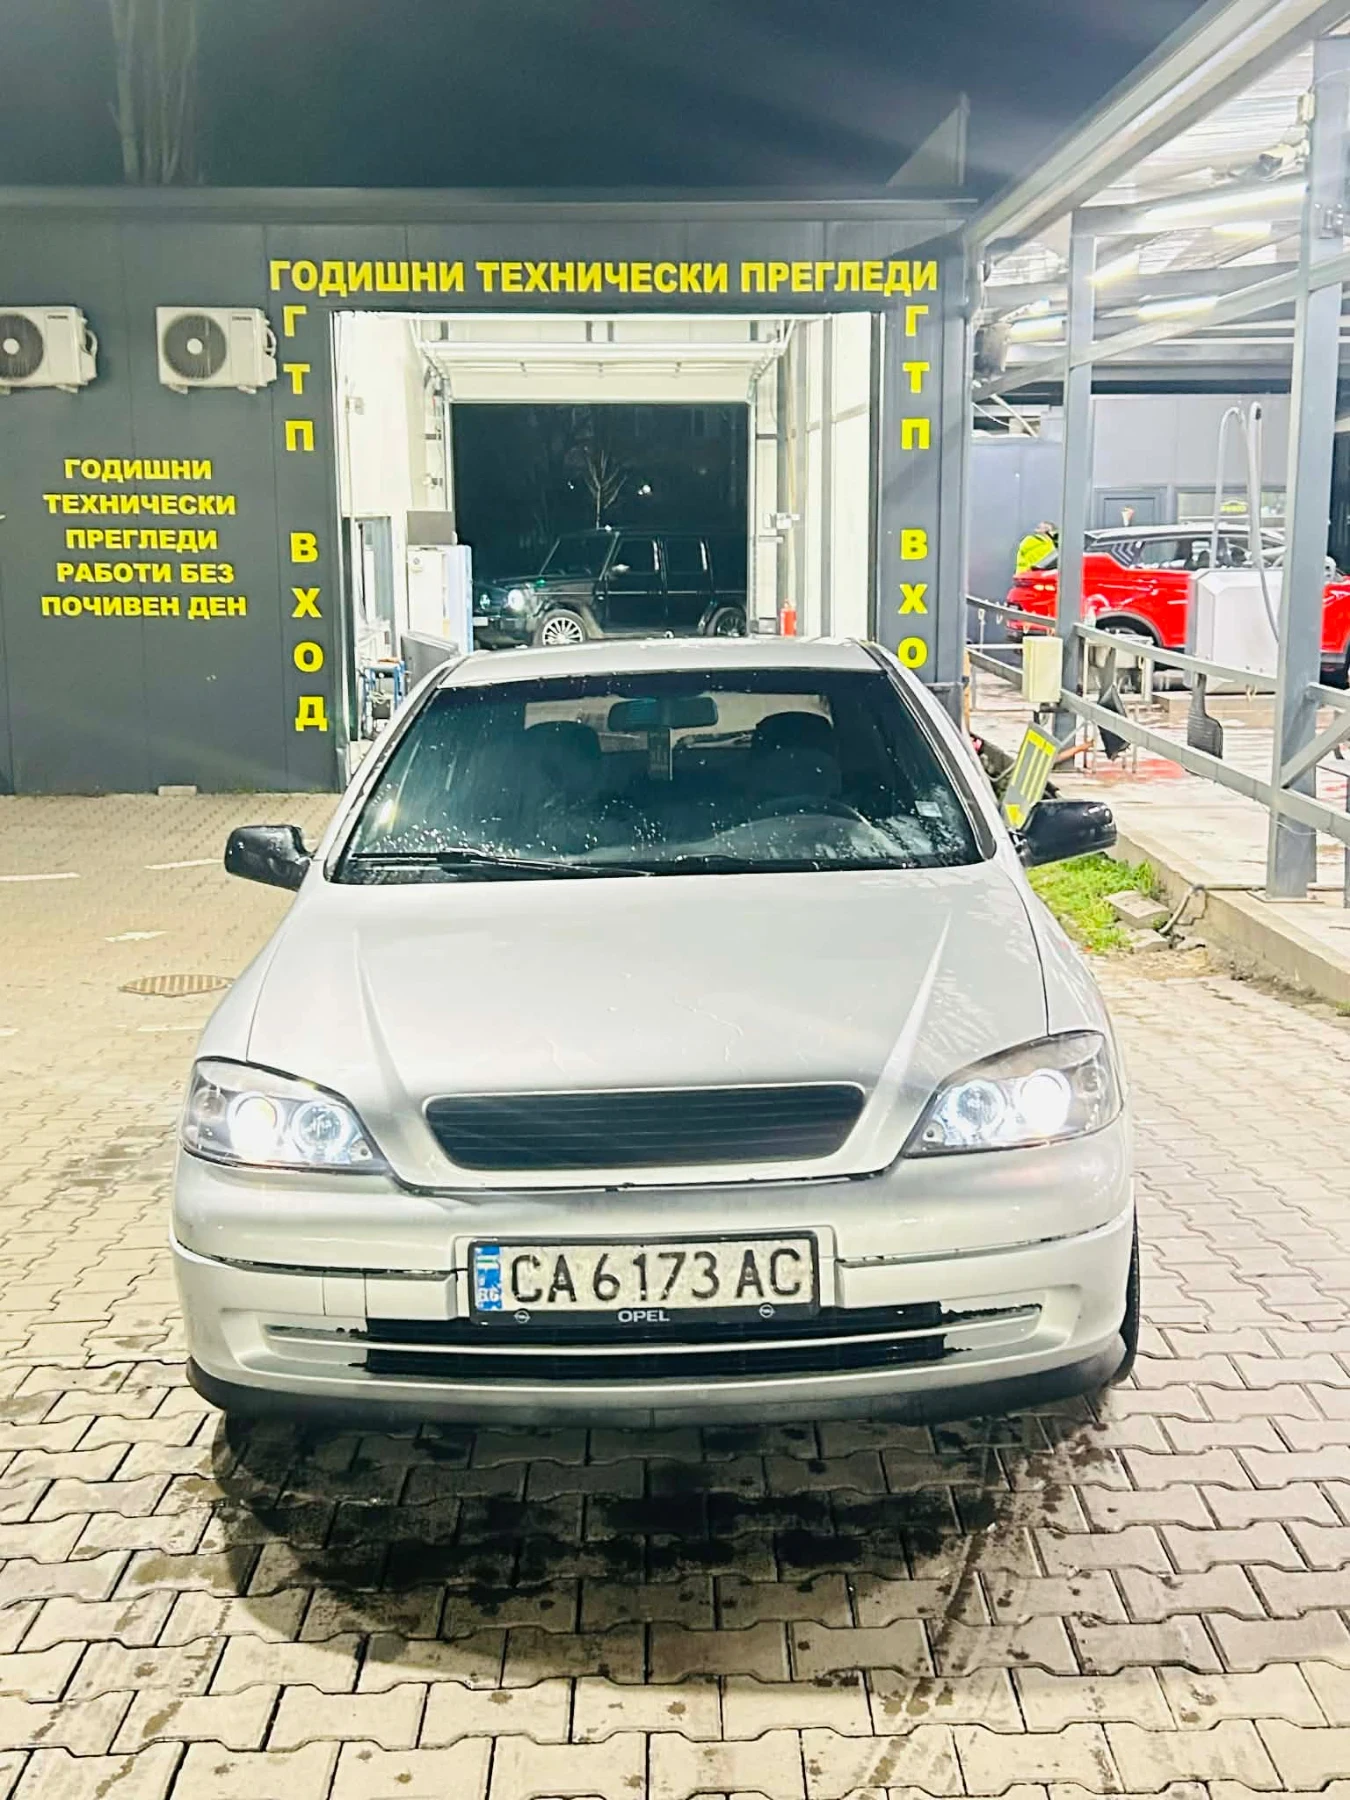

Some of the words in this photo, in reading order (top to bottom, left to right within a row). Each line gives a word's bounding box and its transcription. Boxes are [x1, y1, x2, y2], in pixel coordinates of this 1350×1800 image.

[270, 260, 465, 295] ГОДИШНИ
[475, 261, 729, 293] ТЕХНИЧЕСКИ
[741, 260, 938, 296] ПРЕГЛЕДИ
[283, 305, 315, 451] ГТП
[902, 305, 930, 450] ГТП
[64, 458, 212, 482] ГОДИШНИ
[43, 494, 236, 515] ТЕХНИЧЕСКИ
[65, 529, 218, 553] ПРЕГЛЕДИ
[57, 563, 172, 584] РАБОТИ
[180, 563, 235, 584] БЕЗ
[41, 596, 181, 618] ПОЧИВЕН
[187, 596, 247, 620] ДЕН
[896, 527, 929, 669] ВХО
[290, 532, 328, 731] ВХОД
[511, 1253, 577, 1303] CA
[592, 1250, 720, 1303] 6173
[736, 1247, 801, 1299] AC
[617, 1309, 671, 1323] OPEL
